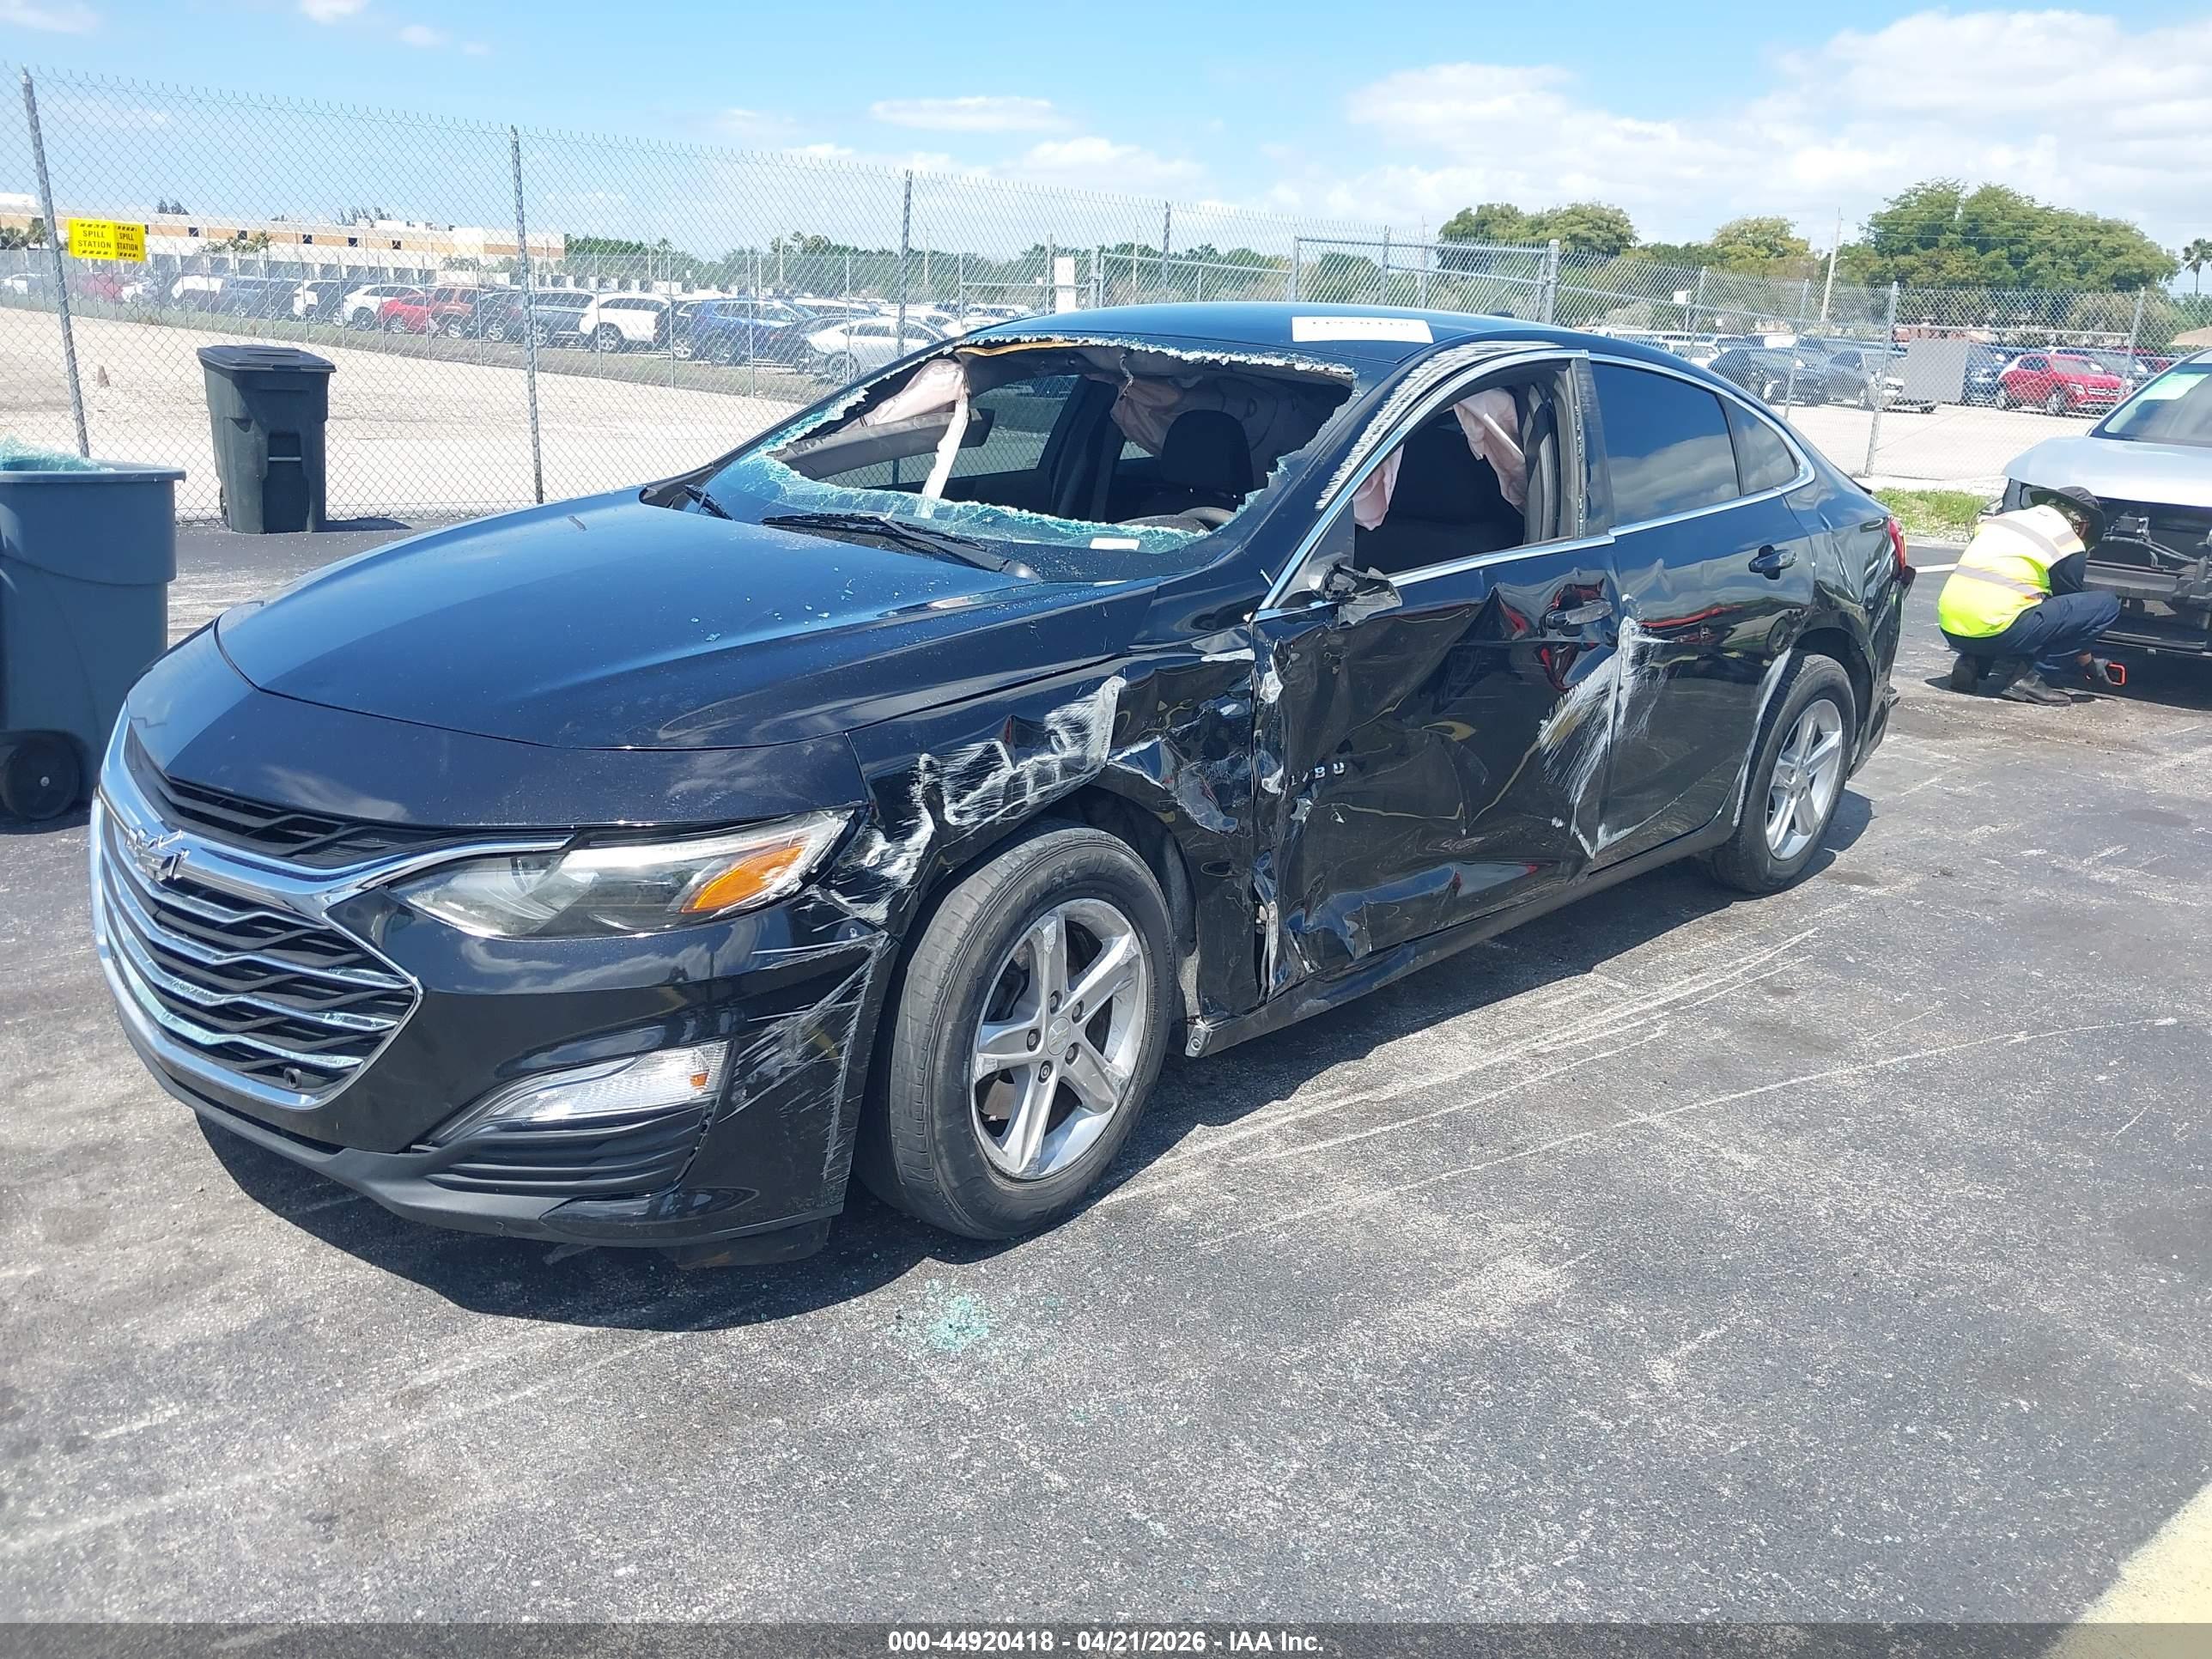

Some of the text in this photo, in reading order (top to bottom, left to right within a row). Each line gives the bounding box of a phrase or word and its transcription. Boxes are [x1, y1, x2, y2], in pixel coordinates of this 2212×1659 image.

[119, 233, 134, 241] SPILL
[77, 240, 112, 249] STATION
[117, 242, 138, 251] STATION
